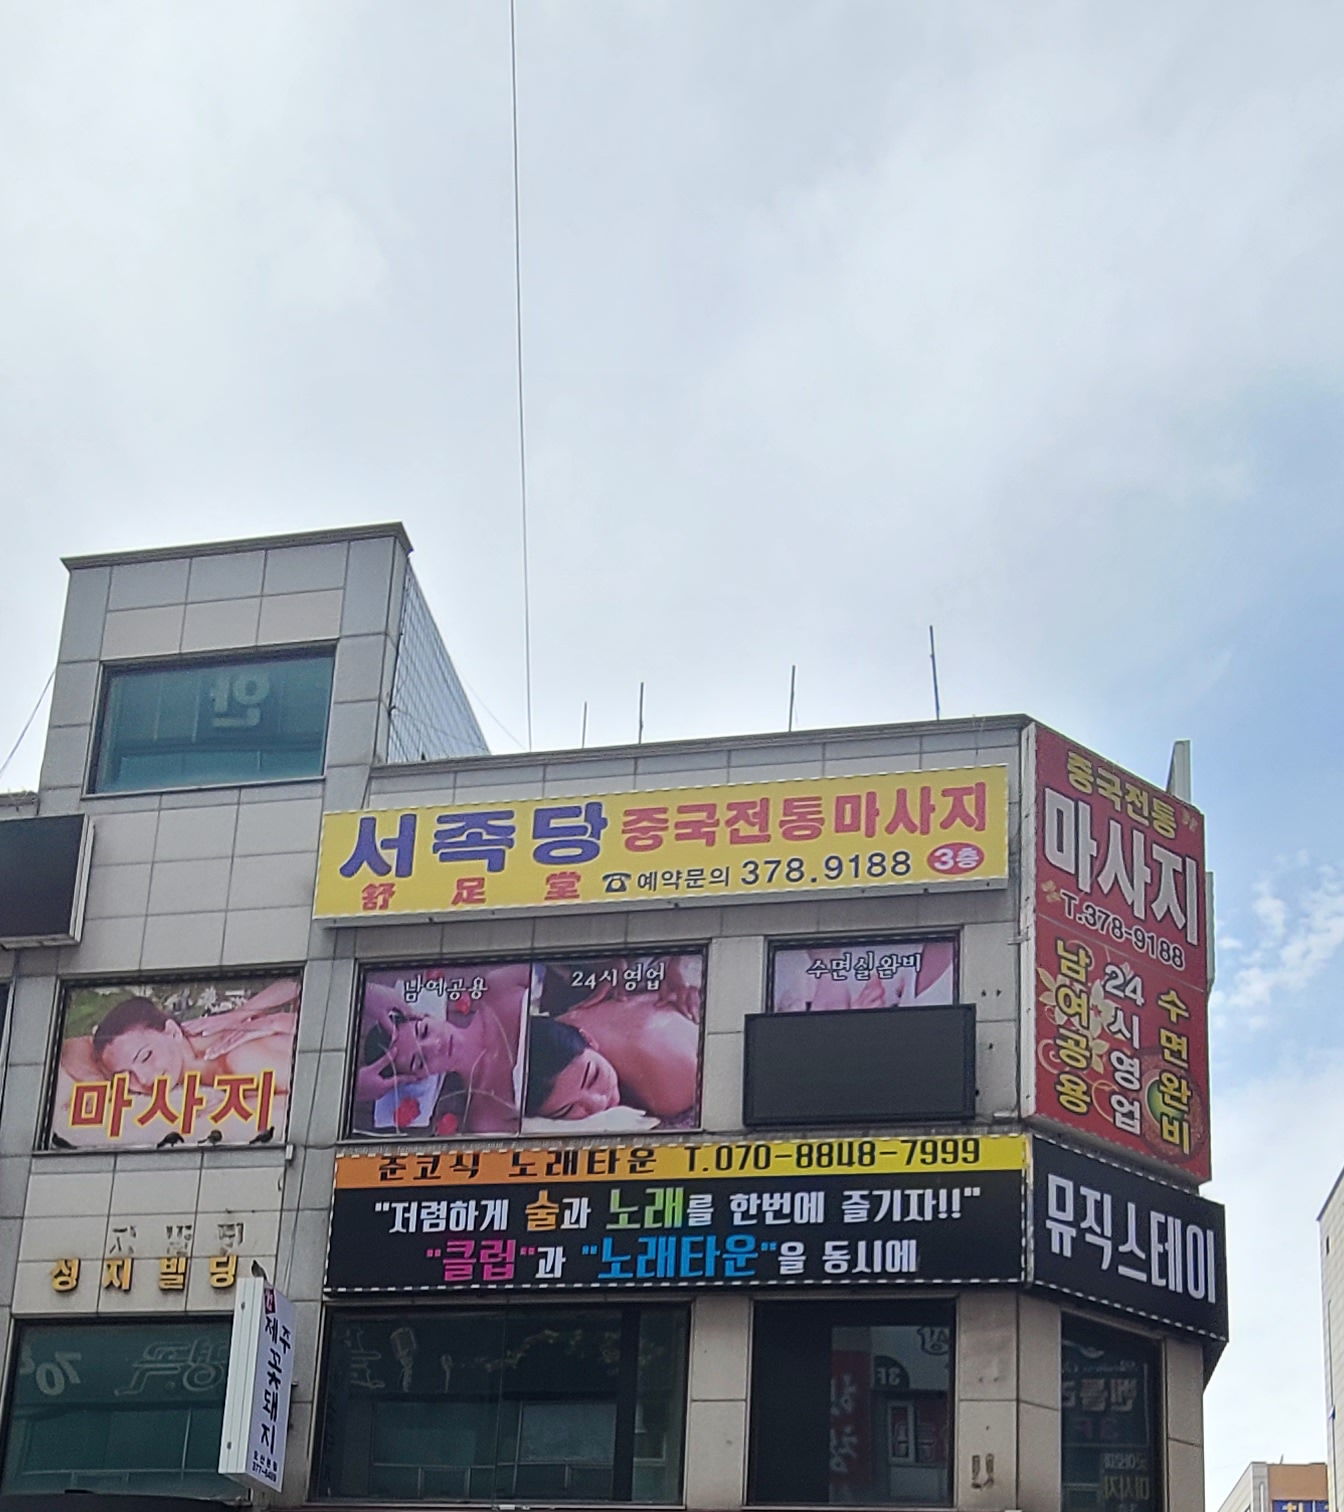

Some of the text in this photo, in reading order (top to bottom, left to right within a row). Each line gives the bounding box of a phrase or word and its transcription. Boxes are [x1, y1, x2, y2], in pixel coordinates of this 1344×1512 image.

[339, 782, 987, 880] 서족당 중국전통마사지
[1067, 751, 1177, 841] 중국전통
[637, 845, 983, 892] 예약문의 378.9188 3층
[1045, 788, 1198, 946] 마사지
[1060, 890, 1185, 971] T.378-9188
[403, 973, 488, 1002] 남여공용
[571, 963, 666, 991] 24시영업
[807, 951, 921, 982] 수면실완비
[1056, 938, 1091, 1116] 남여공용
[1102, 963, 1144, 1134] 24시영업
[70, 1069, 277, 1139] 마사지
[1158, 988, 1192, 1154] 수면완비
[378, 1137, 980, 1182] 준코식 노래타운 T.070-8848-7999
[525, 1190, 591, 1231] 술과
[606, 1186, 713, 1230] 노래를
[729, 1191, 825, 1226] 한번에
[1045, 1172, 1216, 1304] 뮤직스테이
[51, 1254, 239, 1292] 성지빌딩
[822, 1239, 917, 1273] 동시에
